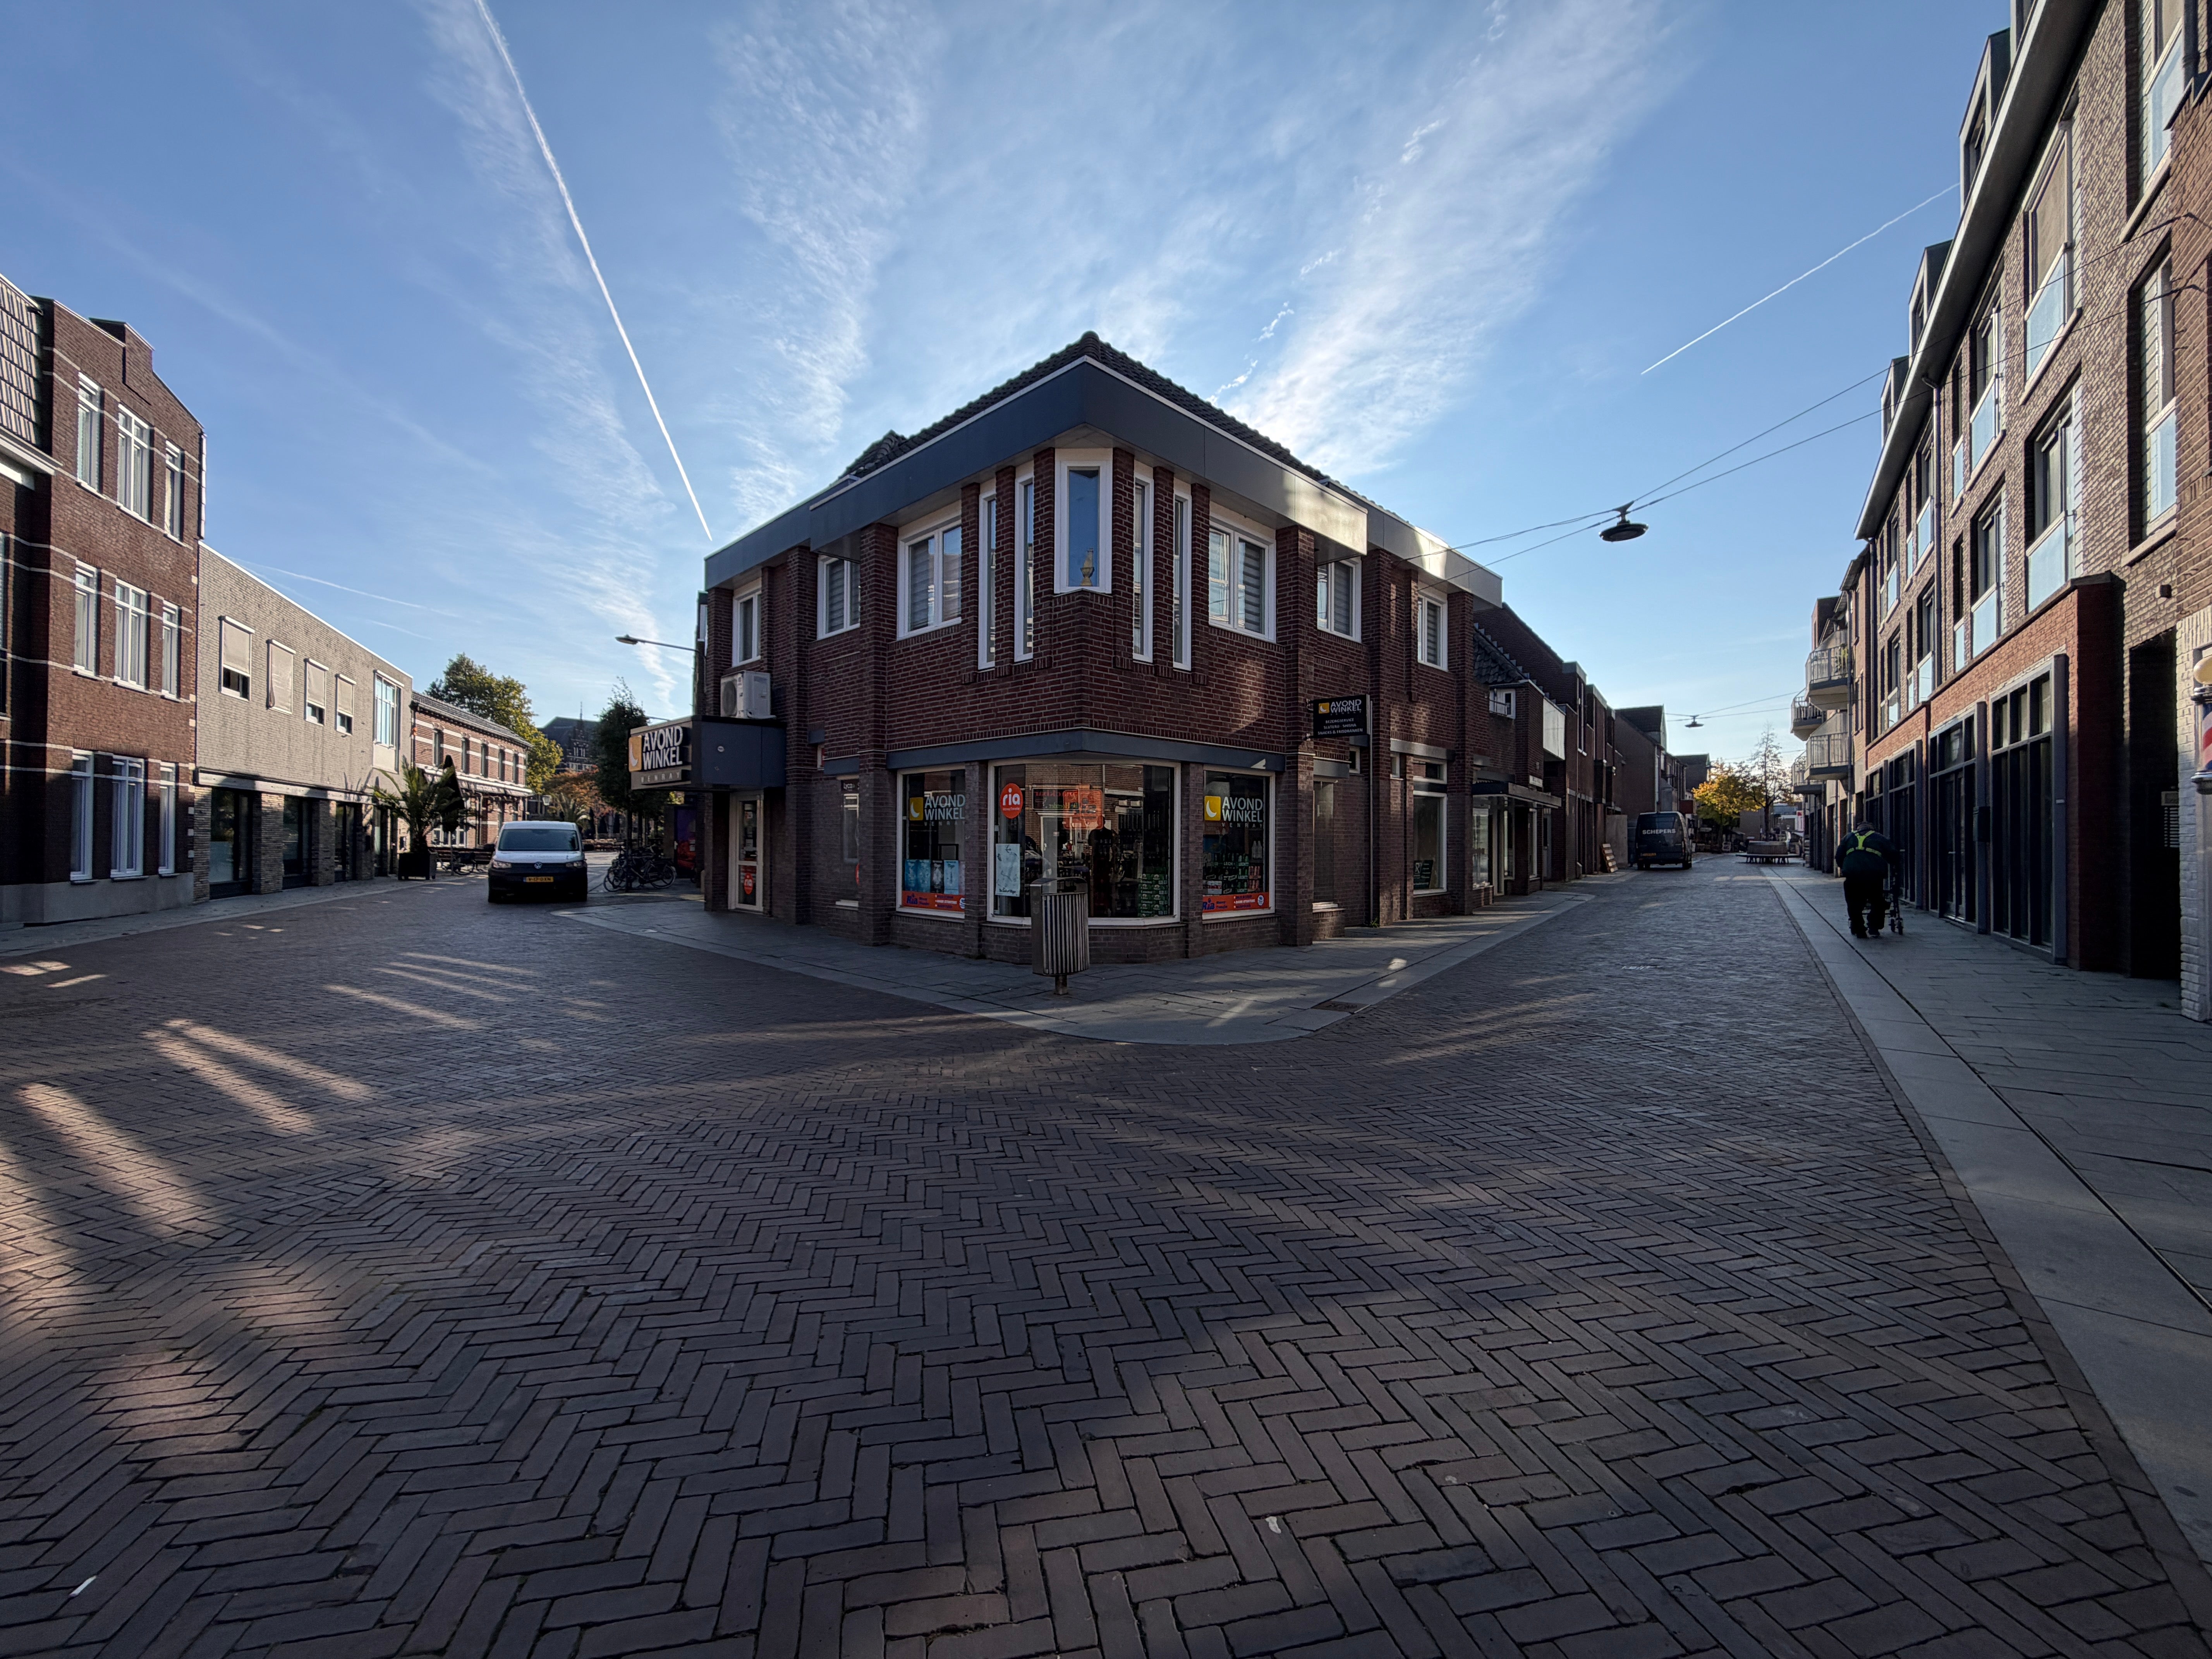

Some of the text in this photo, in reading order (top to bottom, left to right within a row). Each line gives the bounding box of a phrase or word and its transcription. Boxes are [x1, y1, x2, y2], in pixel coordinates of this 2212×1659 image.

[1331, 699, 1362, 708] AVOND
[643, 726, 683, 752] AVOND
[643, 746, 683, 770] WINKEL
[641, 771, 680, 783] VENRAY
[924, 794, 965, 809] AVOND
[1003, 788, 1020, 805] ria
[1222, 796, 1263, 811] AVOND
[924, 807, 965, 821] WINKEL
[1222, 809, 1263, 822] WINKEL
